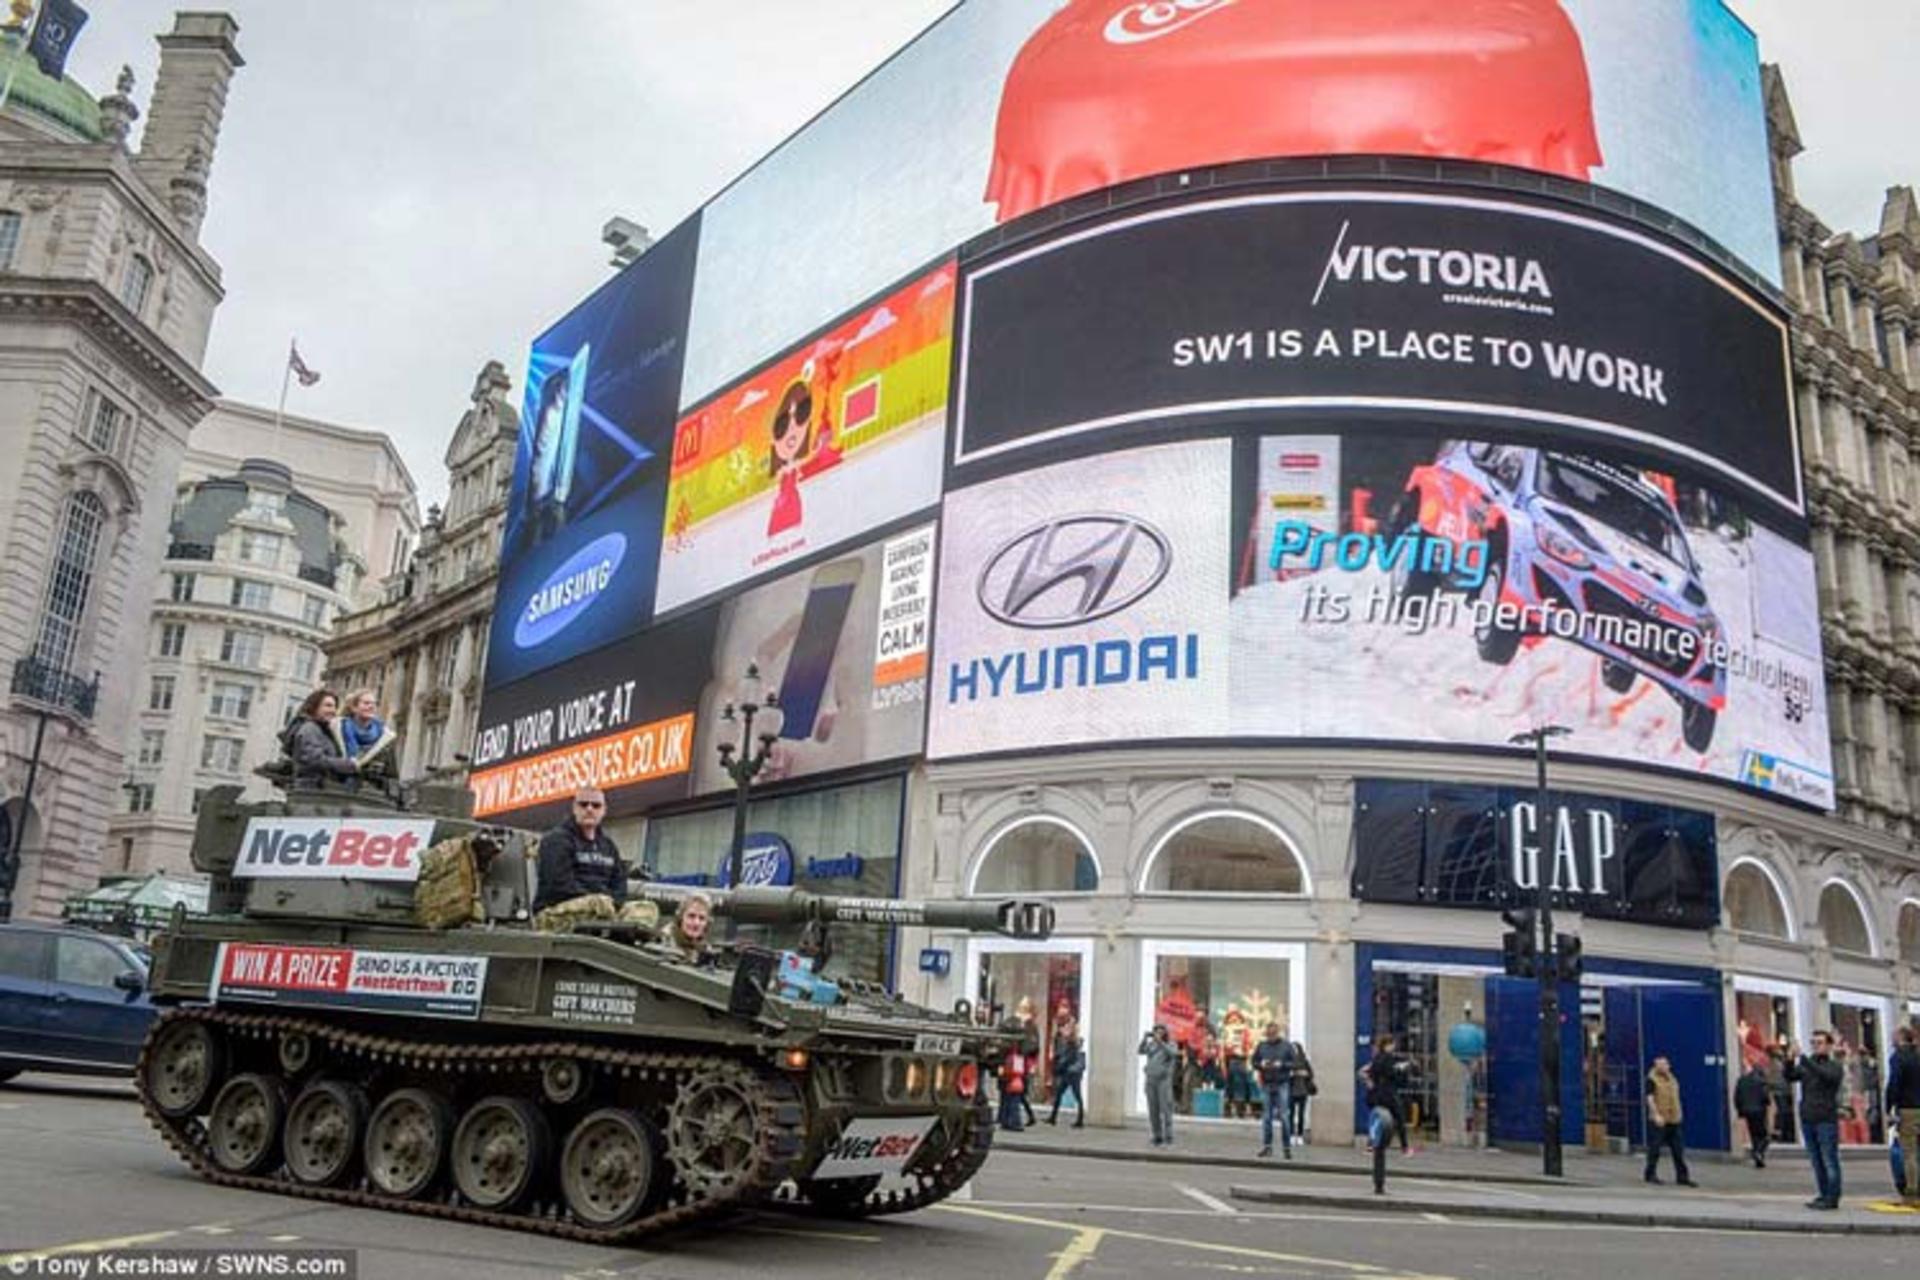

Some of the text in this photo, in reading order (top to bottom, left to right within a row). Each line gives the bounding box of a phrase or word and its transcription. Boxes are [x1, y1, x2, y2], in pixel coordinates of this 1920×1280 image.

[1331, 246, 1552, 298] VICTORIA
[1173, 330, 1668, 405] SW1 IS A PLACE TO WORK
[1269, 520, 1489, 588] Proving
[528, 558, 611, 624] SAMSUNG
[879, 622, 925, 656] CALM
[949, 634, 1198, 703] HYUNDAI
[1302, 586, 1349, 622] its
[1364, 585, 1468, 635] high
[1474, 597, 1696, 660] performance
[1702, 630, 1813, 713] technology
[474, 681, 636, 766] LEND YOUR VOICE AT
[245, 827, 419, 868] NetBet
[1511, 801, 1615, 895] GAP
[232, 949, 342, 988] WIN A PRIZE
[356, 956, 480, 979] SEND US A PICTURE
